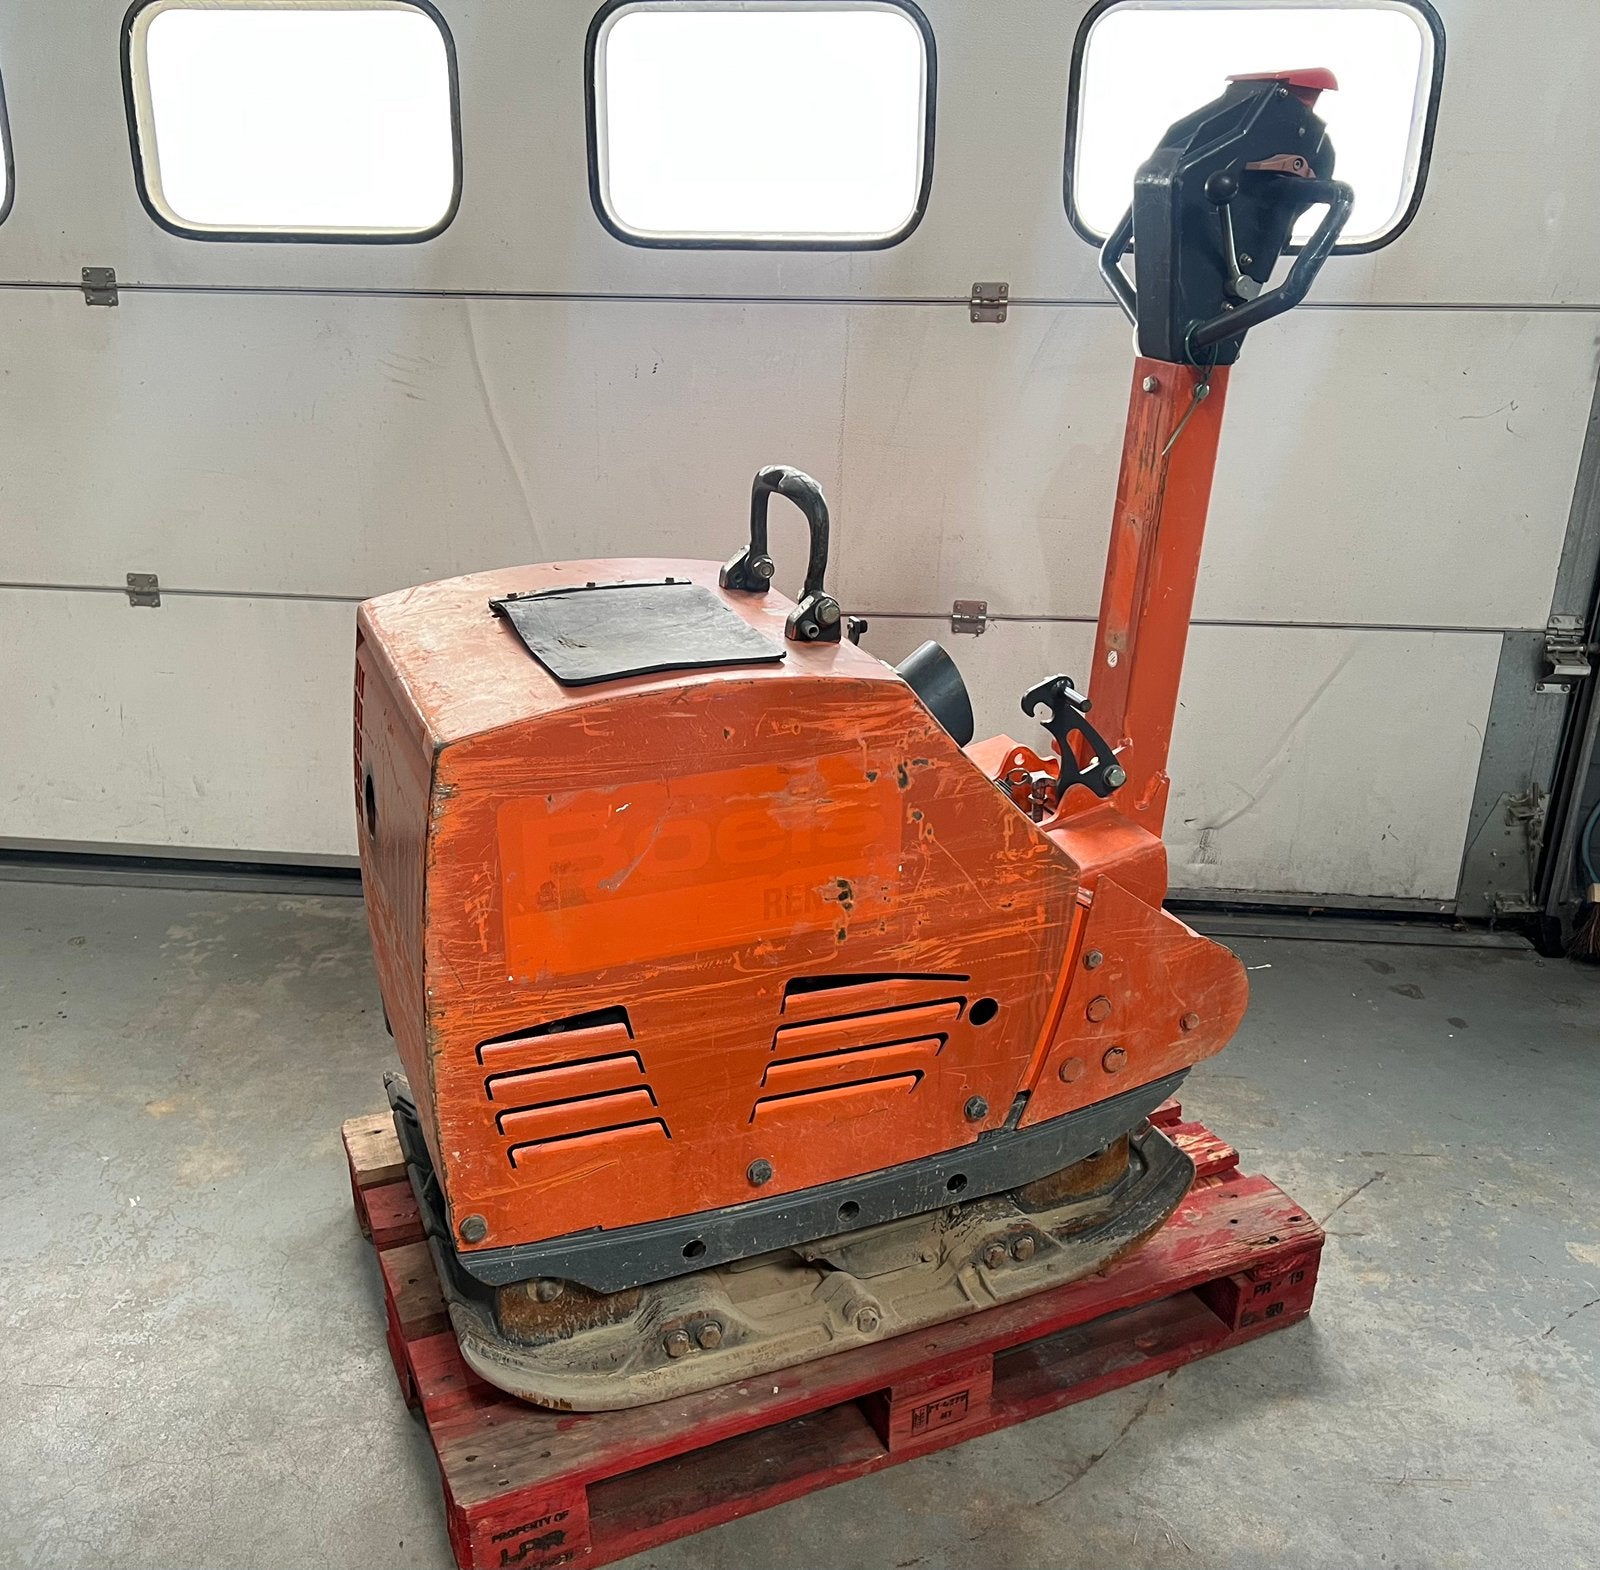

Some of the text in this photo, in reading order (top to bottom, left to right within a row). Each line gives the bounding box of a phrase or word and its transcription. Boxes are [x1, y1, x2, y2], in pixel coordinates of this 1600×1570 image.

[1253, 1281, 1272, 1298] PR
[491, 1509, 570, 1544] PROPERTY OF
